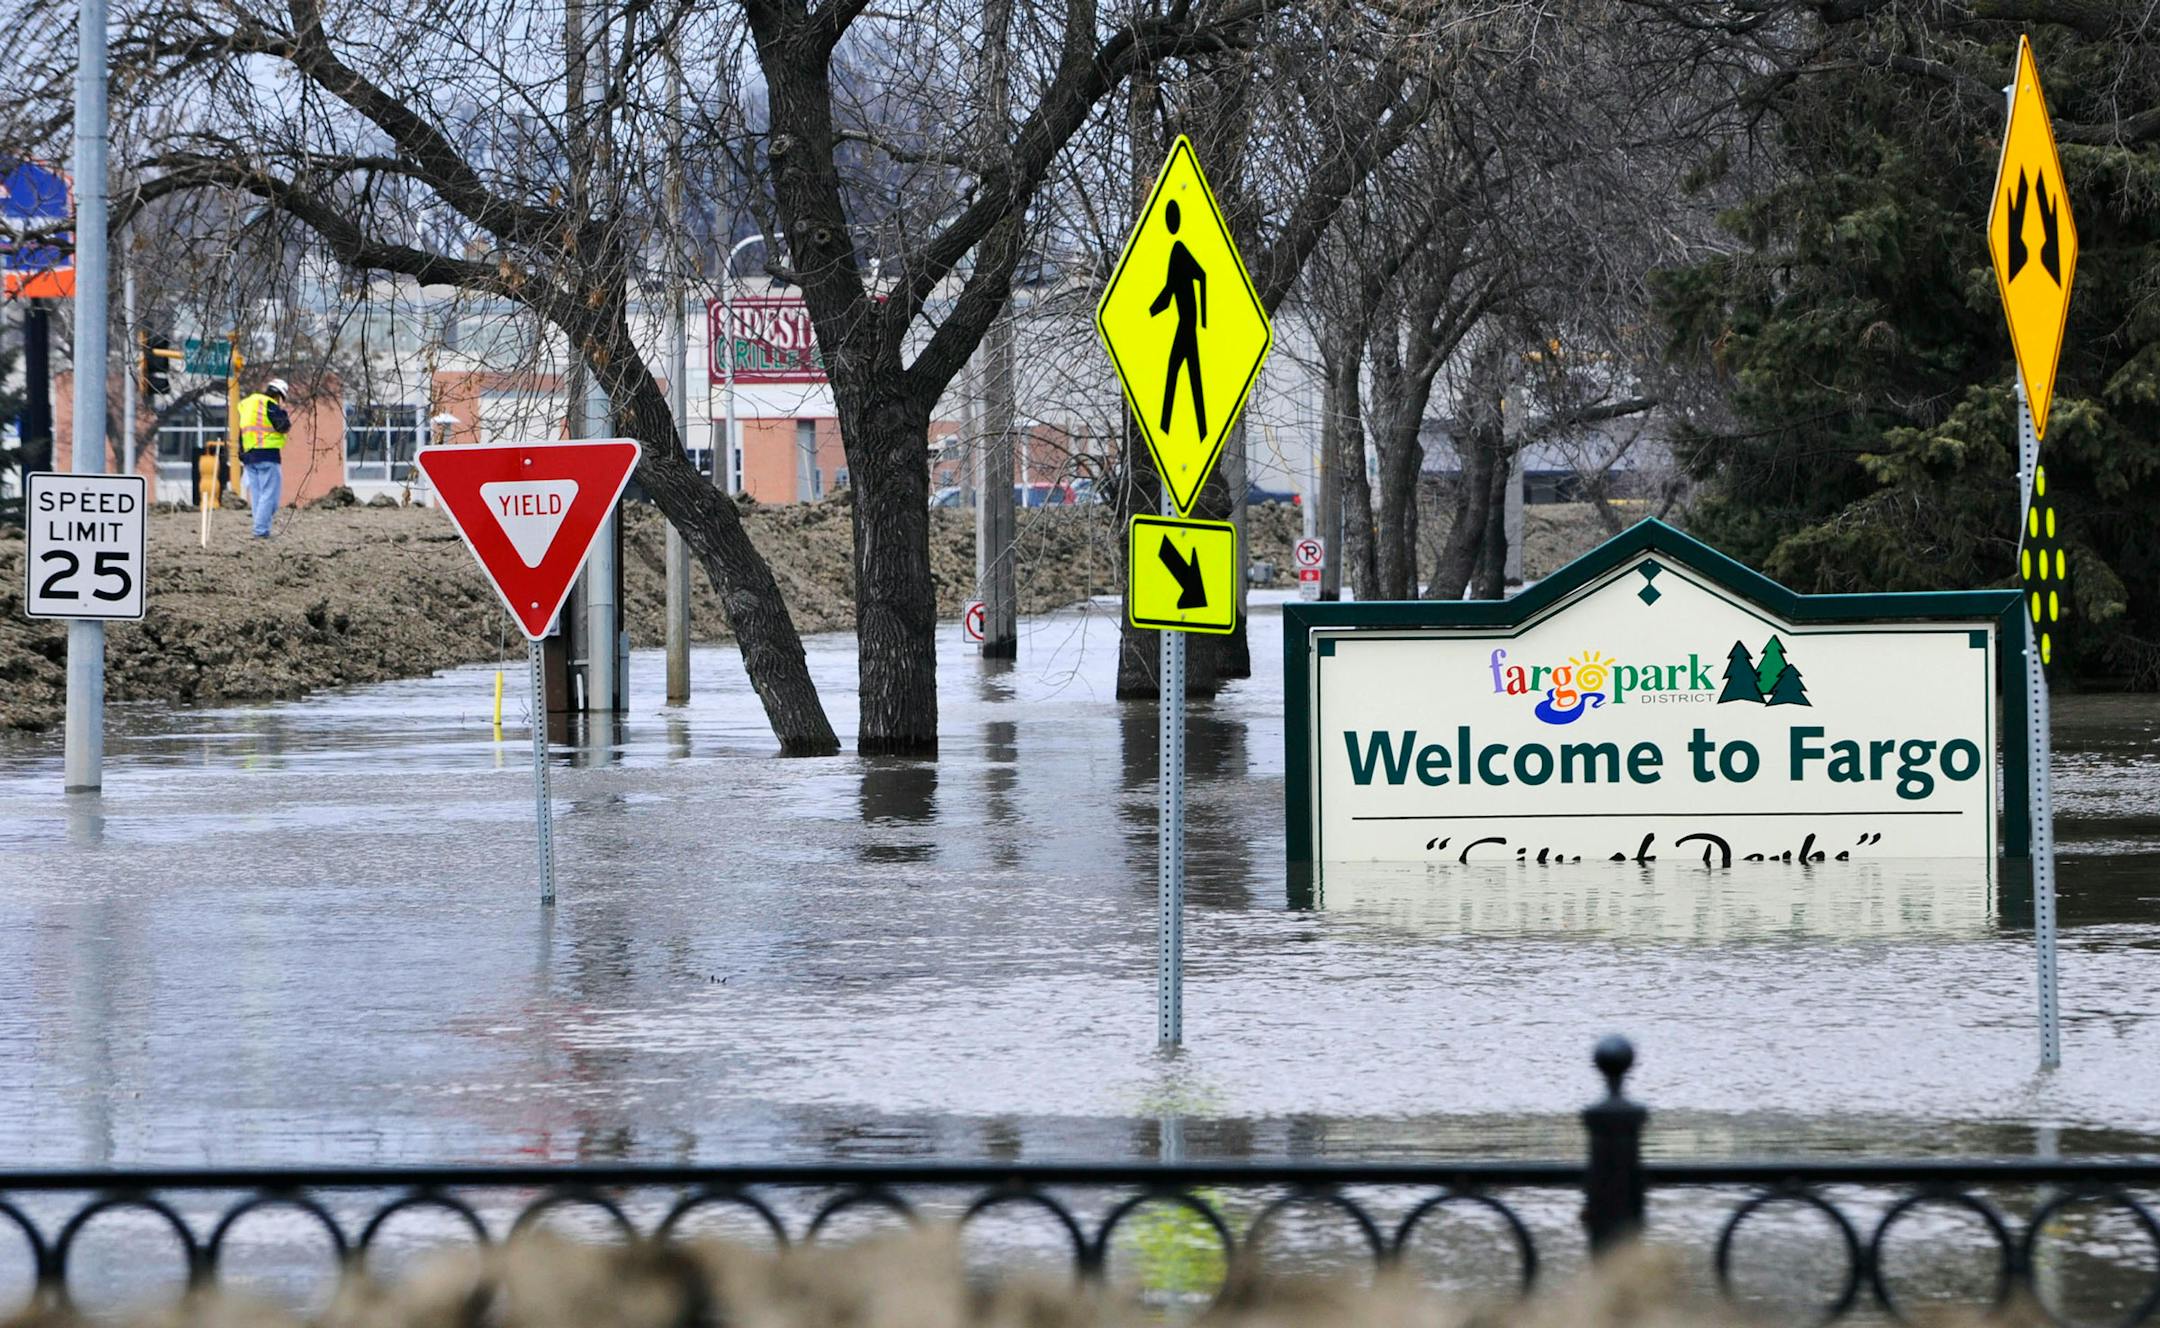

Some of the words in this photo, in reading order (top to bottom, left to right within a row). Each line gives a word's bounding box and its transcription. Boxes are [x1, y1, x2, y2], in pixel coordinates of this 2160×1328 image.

[39, 491, 135, 514] SPEED
[499, 494, 562, 517] YIELD
[49, 521, 124, 543] LIMIT
[39, 549, 132, 602] 25
[1612, 653, 1716, 705] park
[1640, 693, 1715, 705] DISTRICT
[1343, 726, 1664, 787] Welcome
[1687, 728, 1761, 781] to
[1789, 725, 1982, 800] Fargo
